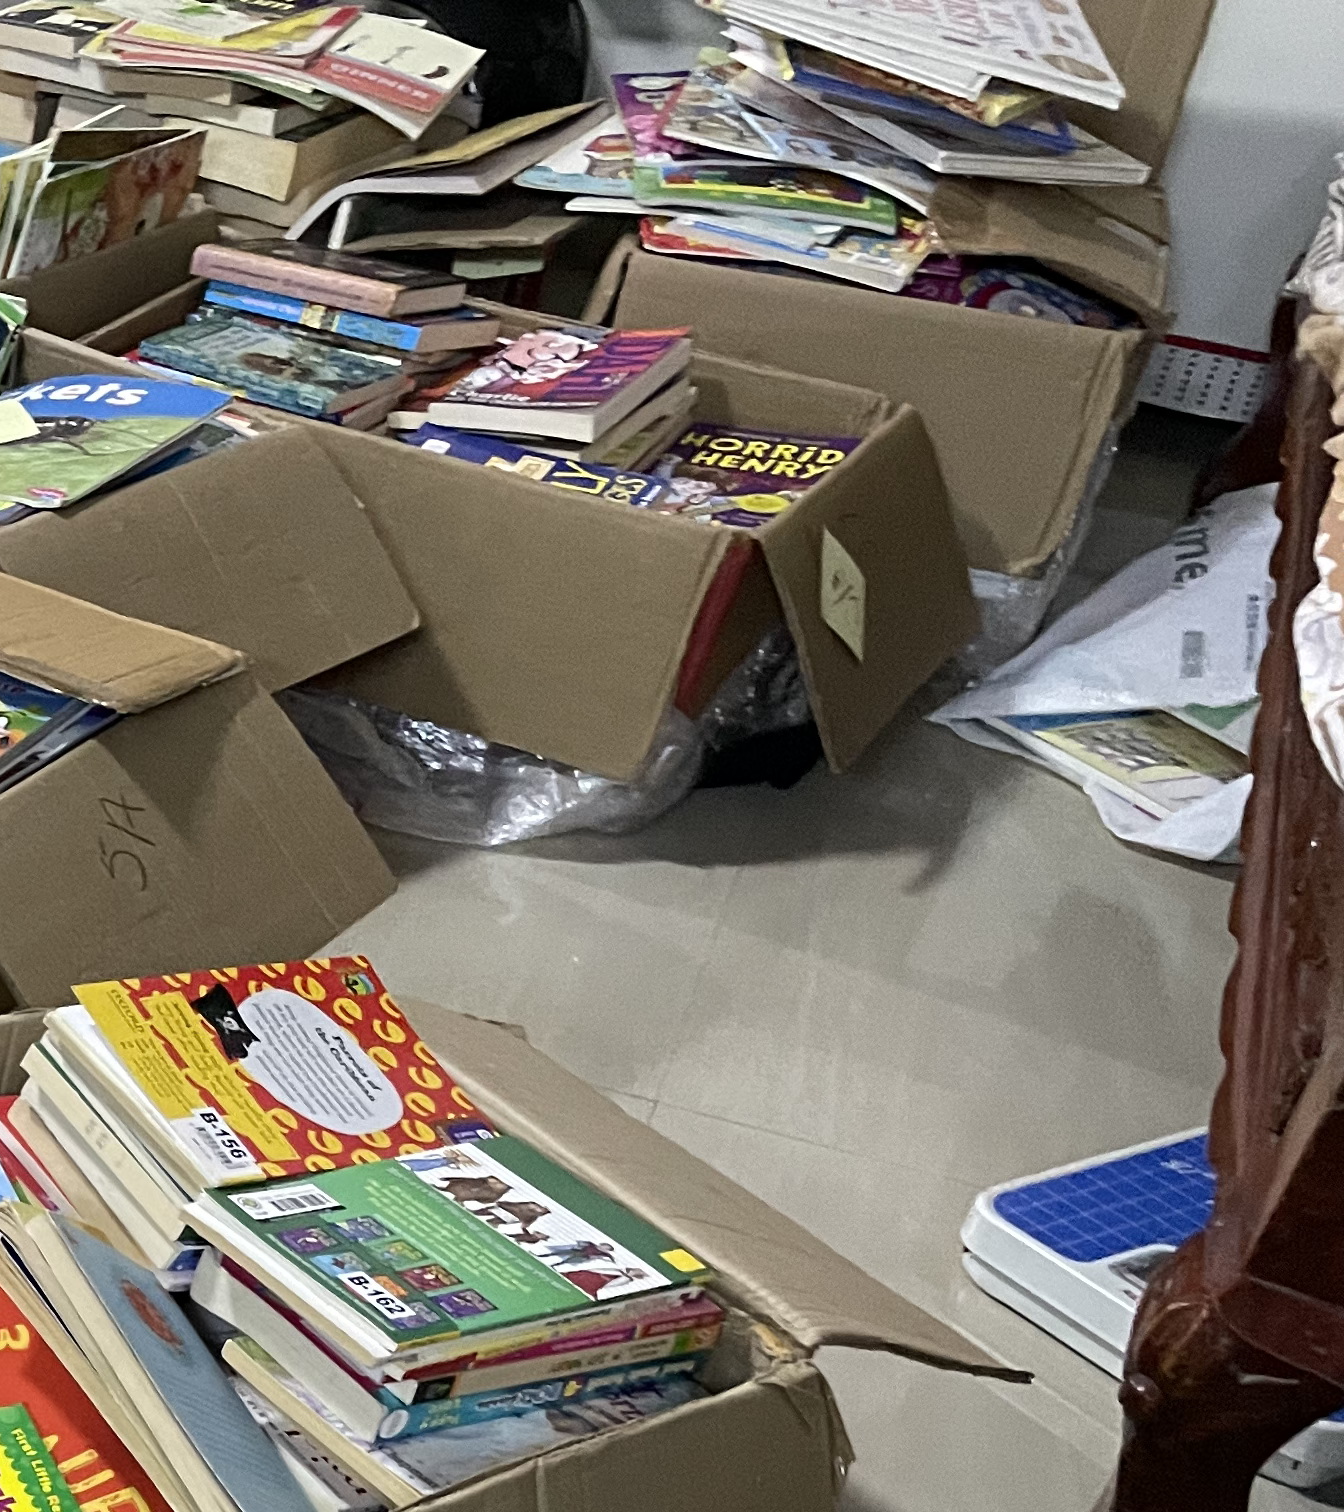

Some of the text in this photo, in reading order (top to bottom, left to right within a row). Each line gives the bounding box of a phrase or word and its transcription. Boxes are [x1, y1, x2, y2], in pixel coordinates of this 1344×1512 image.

[14, 382, 149, 406] kets
[692, 450, 836, 480] HENRY
[347, 1273, 406, 1316] B-162
[10, 1427, 38, 1458] First
[30, 1459, 54, 1496] Little
